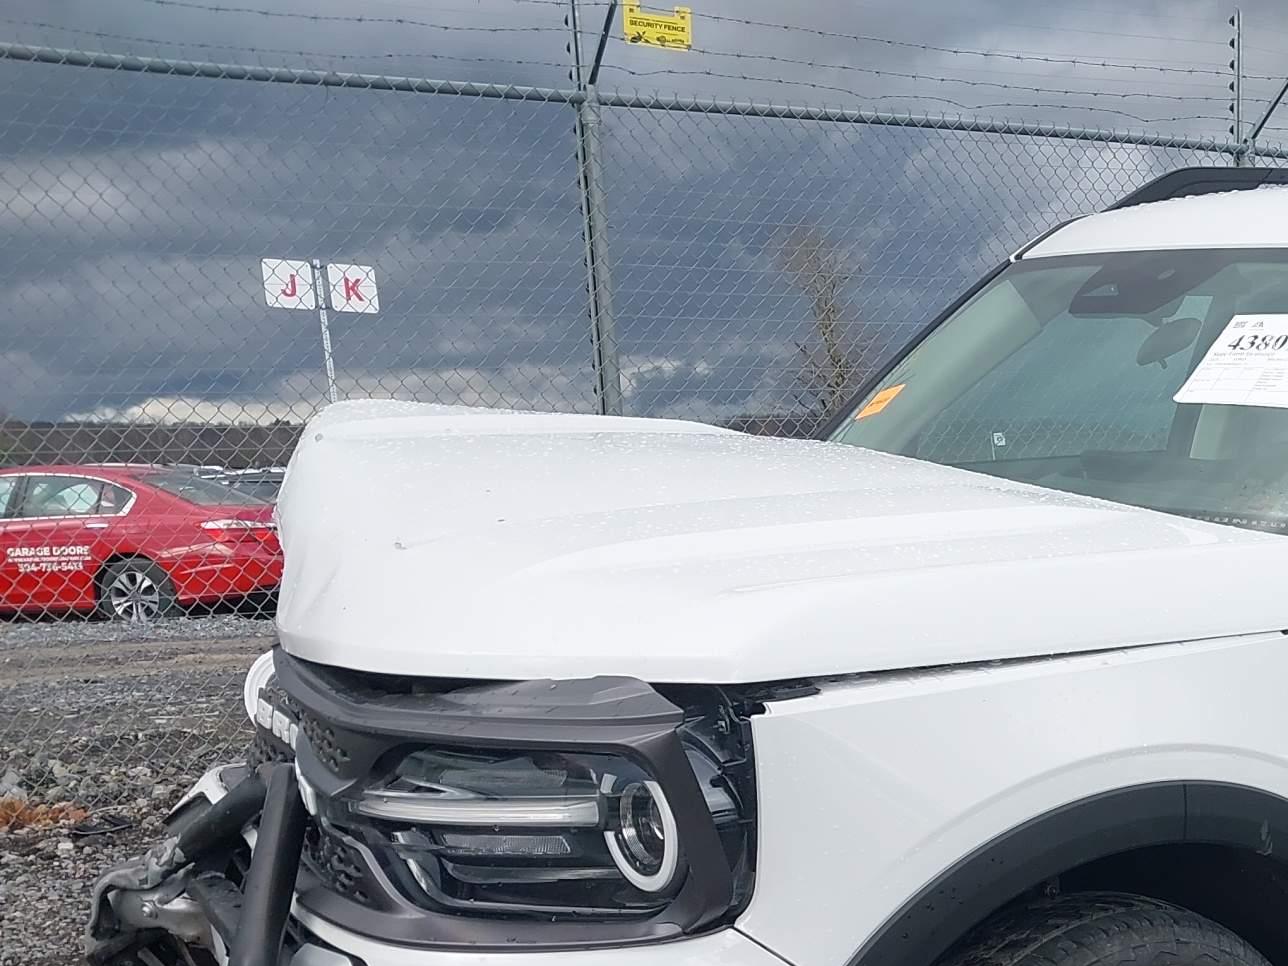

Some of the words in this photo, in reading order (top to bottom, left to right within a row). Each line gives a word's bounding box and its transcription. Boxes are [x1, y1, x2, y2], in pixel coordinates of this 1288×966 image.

[629, 19, 663, 30] SECURITY
[663, 24, 686, 32] FENCE
[281, 273, 298, 298] J
[343, 275, 365, 302] K
[7, 546, 50, 557] GARAGE
[52, 545, 90, 556] DOORS
